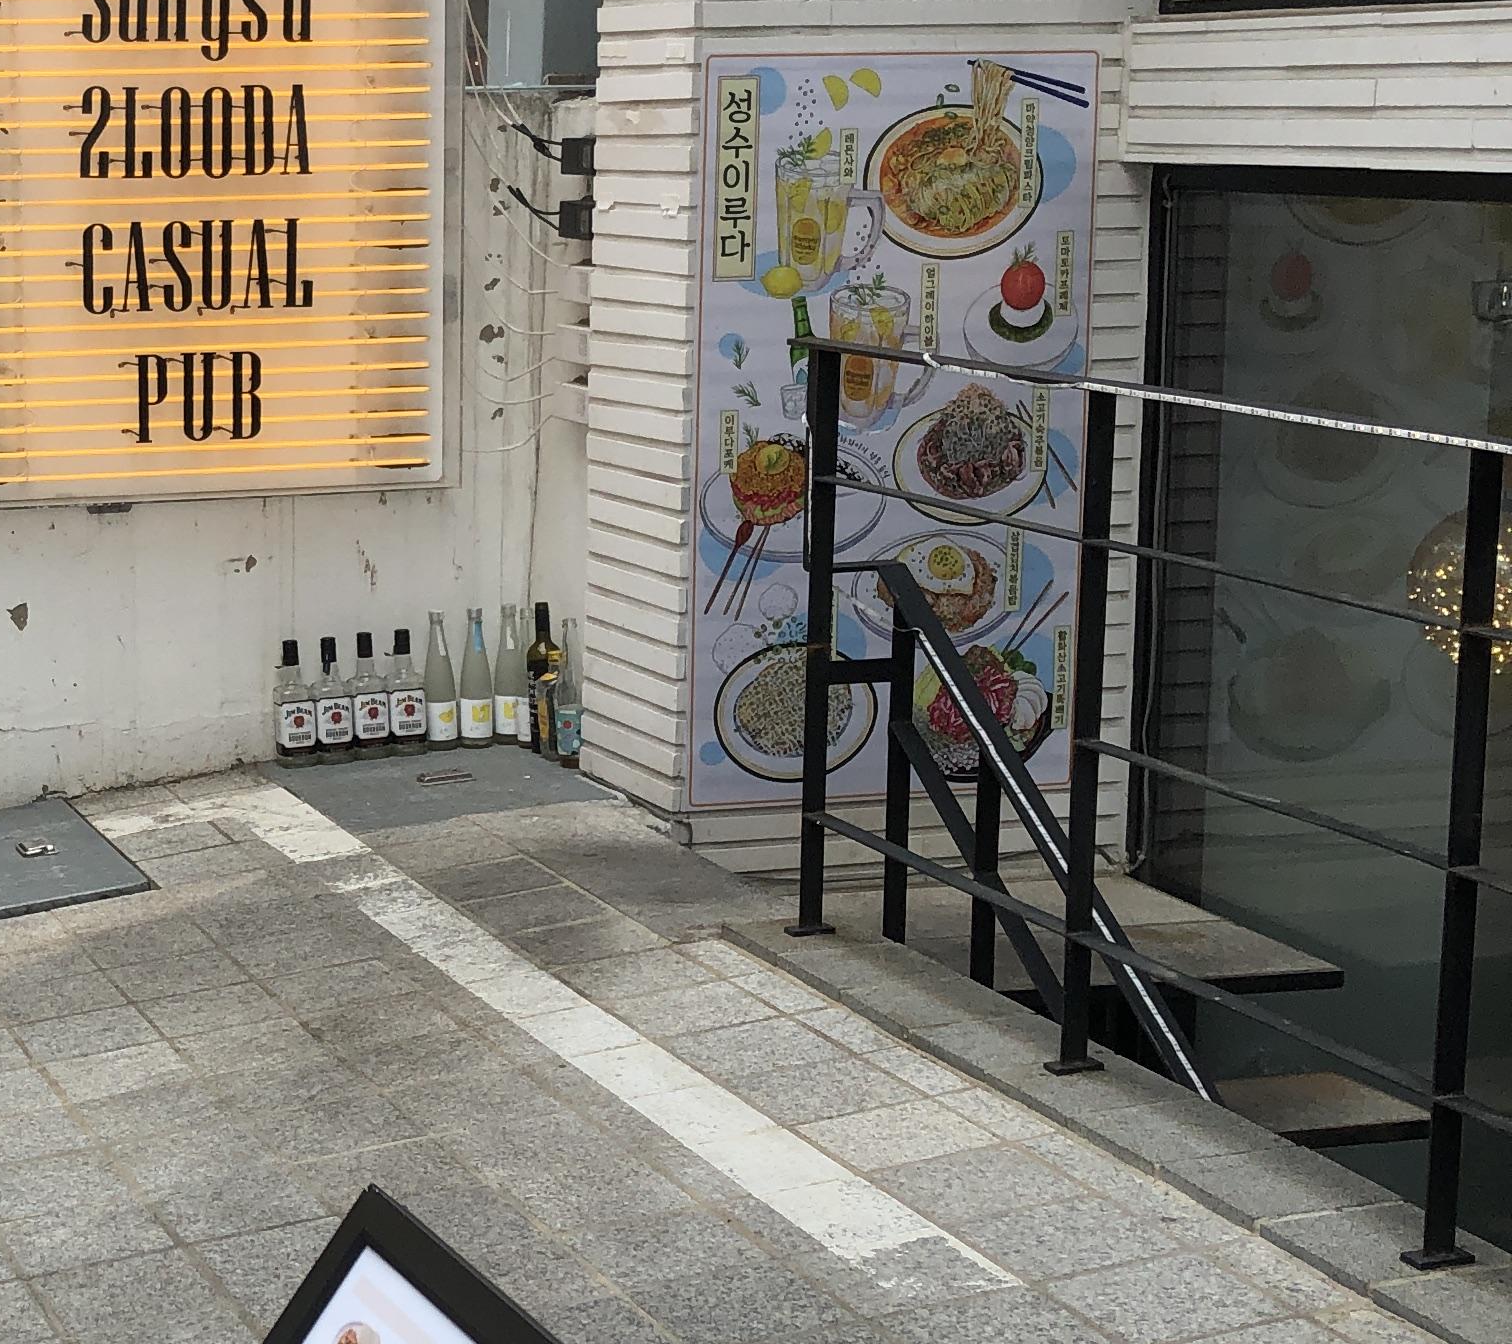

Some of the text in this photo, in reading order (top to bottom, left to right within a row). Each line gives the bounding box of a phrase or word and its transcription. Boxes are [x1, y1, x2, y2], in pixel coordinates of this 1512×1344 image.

[79, 84, 313, 179] 2LOODA
[719, 89, 753, 263] 성수이루다
[843, 133, 855, 178] 레몬사와
[82, 217, 314, 315] CASUAL
[135, 351, 262, 444] PUB
